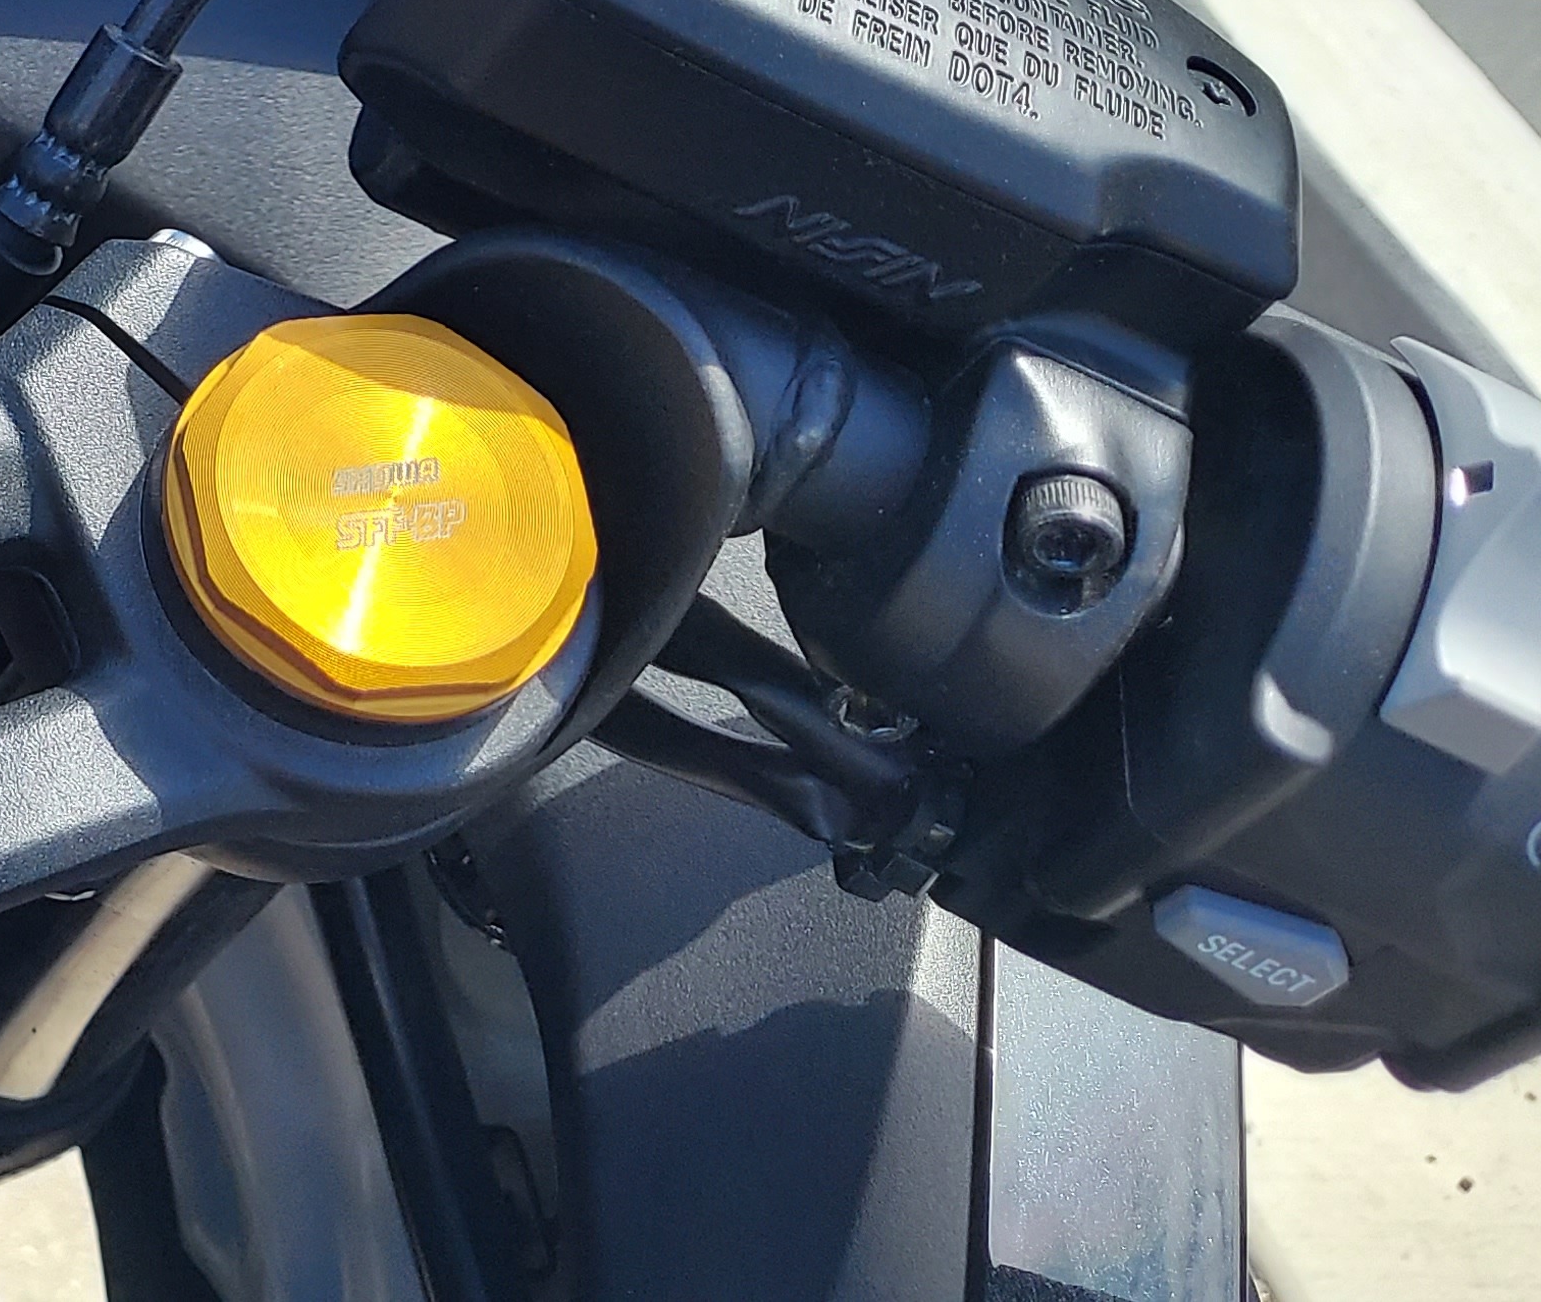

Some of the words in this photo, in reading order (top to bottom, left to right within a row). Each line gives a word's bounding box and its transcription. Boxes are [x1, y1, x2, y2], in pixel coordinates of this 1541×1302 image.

[850, 8, 932, 68] FREIN
[947, 49, 1043, 122] DOT4.
[953, 19, 1011, 68] QUE
[1022, 49, 1061, 89] DU
[1072, 73, 1167, 143] FLUIDE
[1063, 37, 1206, 130] REMOVING.
[1197, 934, 1314, 993] SELECT
